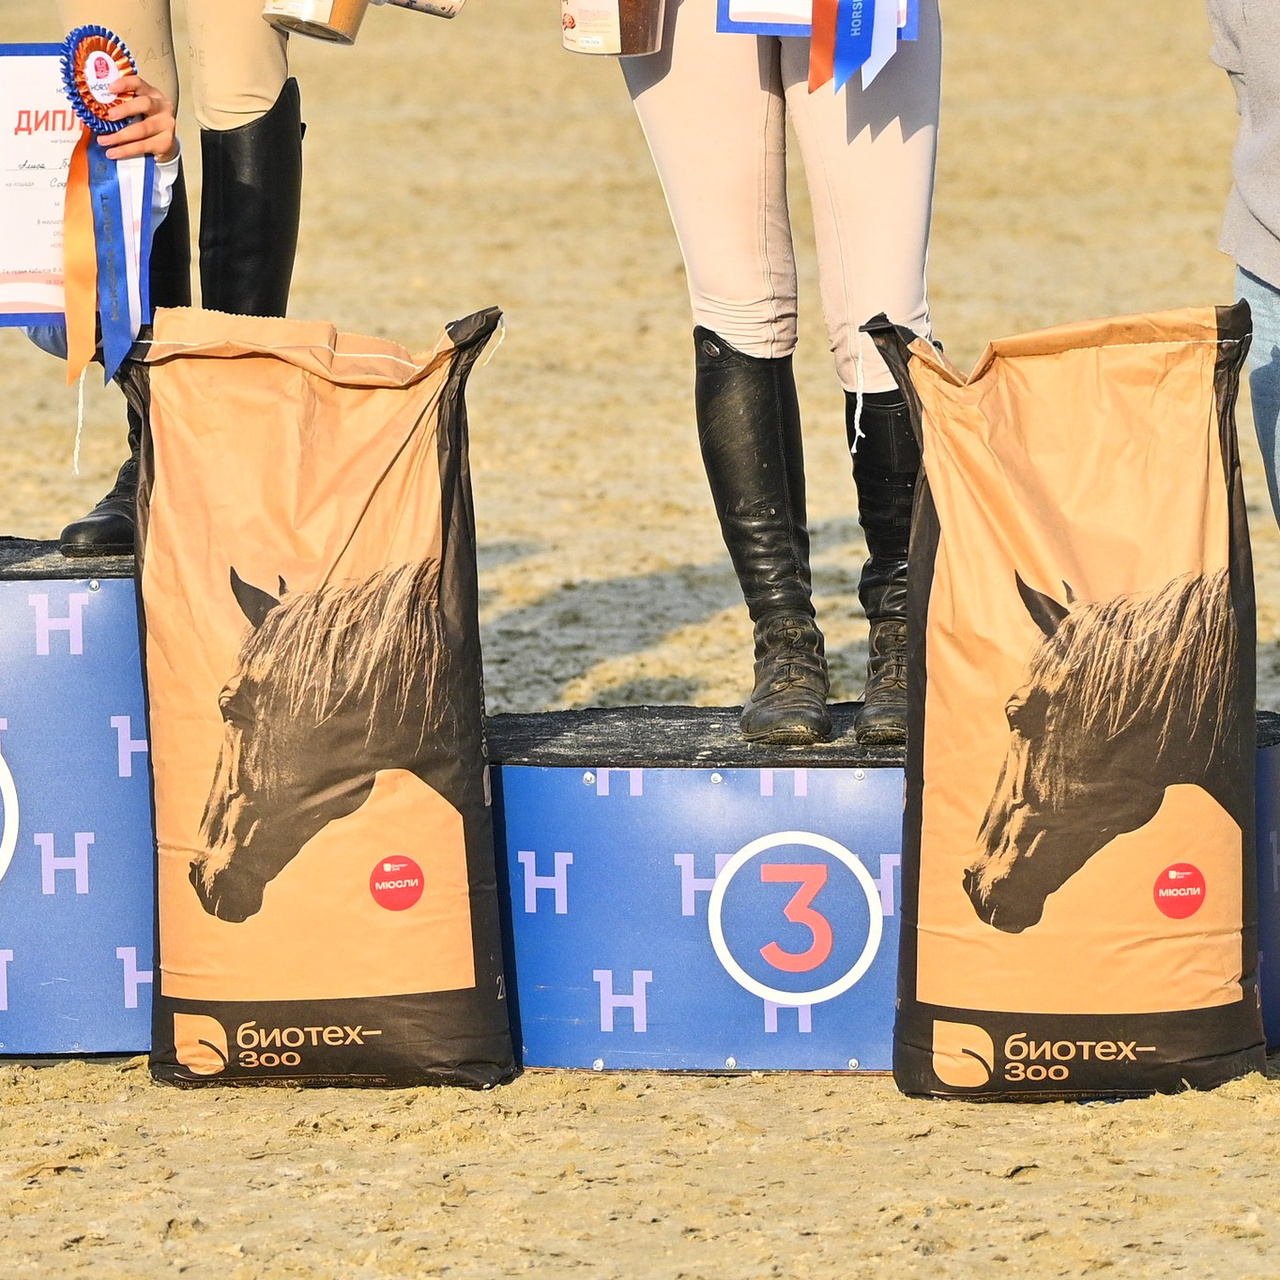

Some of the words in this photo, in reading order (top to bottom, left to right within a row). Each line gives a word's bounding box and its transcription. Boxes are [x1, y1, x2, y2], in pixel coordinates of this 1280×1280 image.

[14, 109, 83, 136] ДИПЛ
[759, 864, 833, 972] 3
[237, 1020, 382, 1049] биотех-
[1004, 1032, 1156, 1061] биотех-
